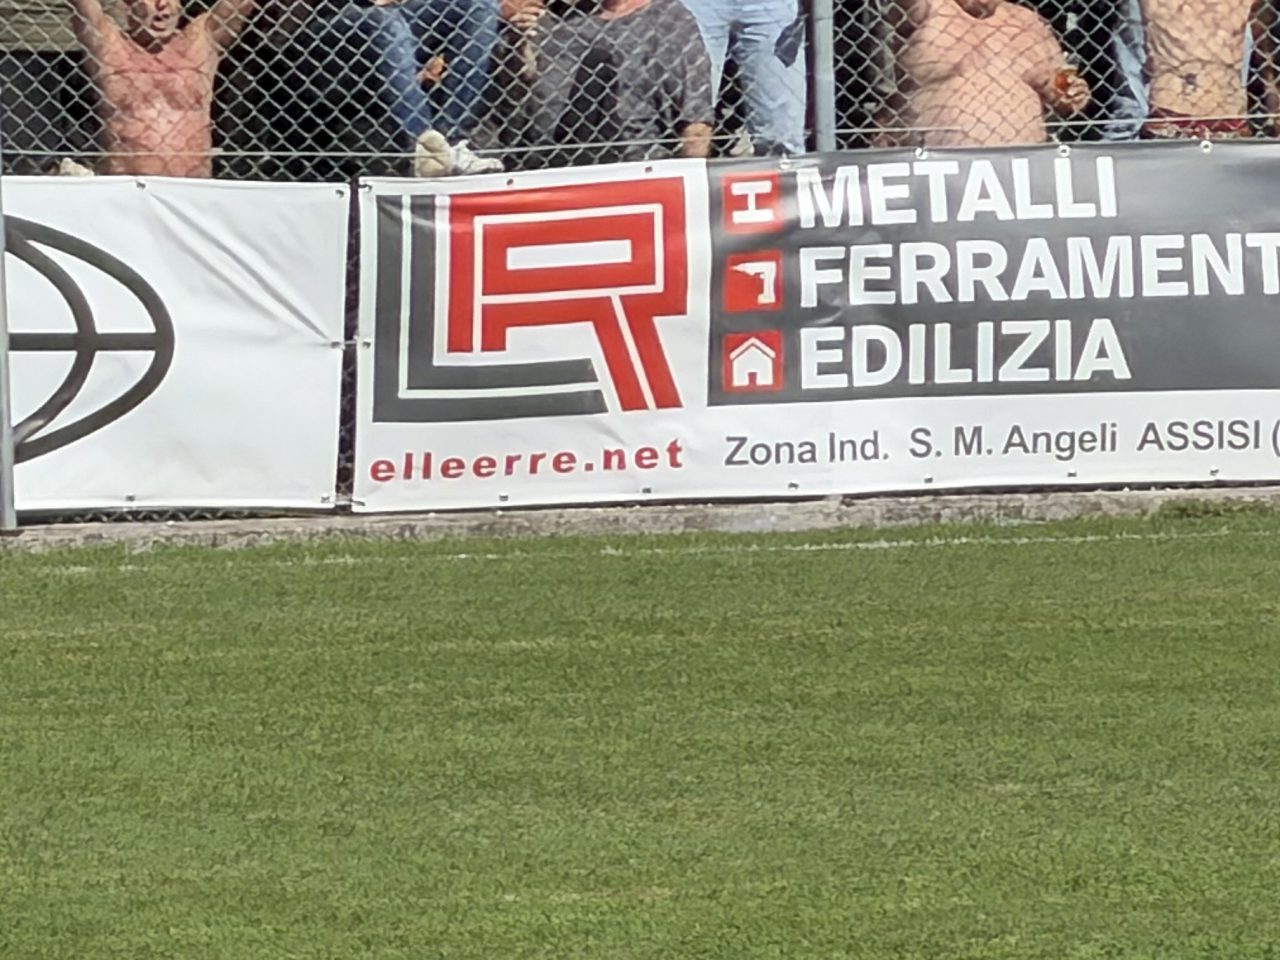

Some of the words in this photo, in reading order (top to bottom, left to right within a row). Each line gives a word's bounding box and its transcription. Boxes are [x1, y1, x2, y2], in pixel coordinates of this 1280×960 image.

[797, 156, 1118, 228] METALLI
[800, 318, 1132, 390] EDILIZIA
[369, 438, 684, 482] elleerre.net
[724, 436, 818, 466] Zona
[829, 430, 890, 463] Ind.
[909, 426, 943, 458] S.
[953, 425, 993, 456] M.
[1001, 422, 1118, 461] Angeli
[1136, 419, 1260, 452] ASSISI
